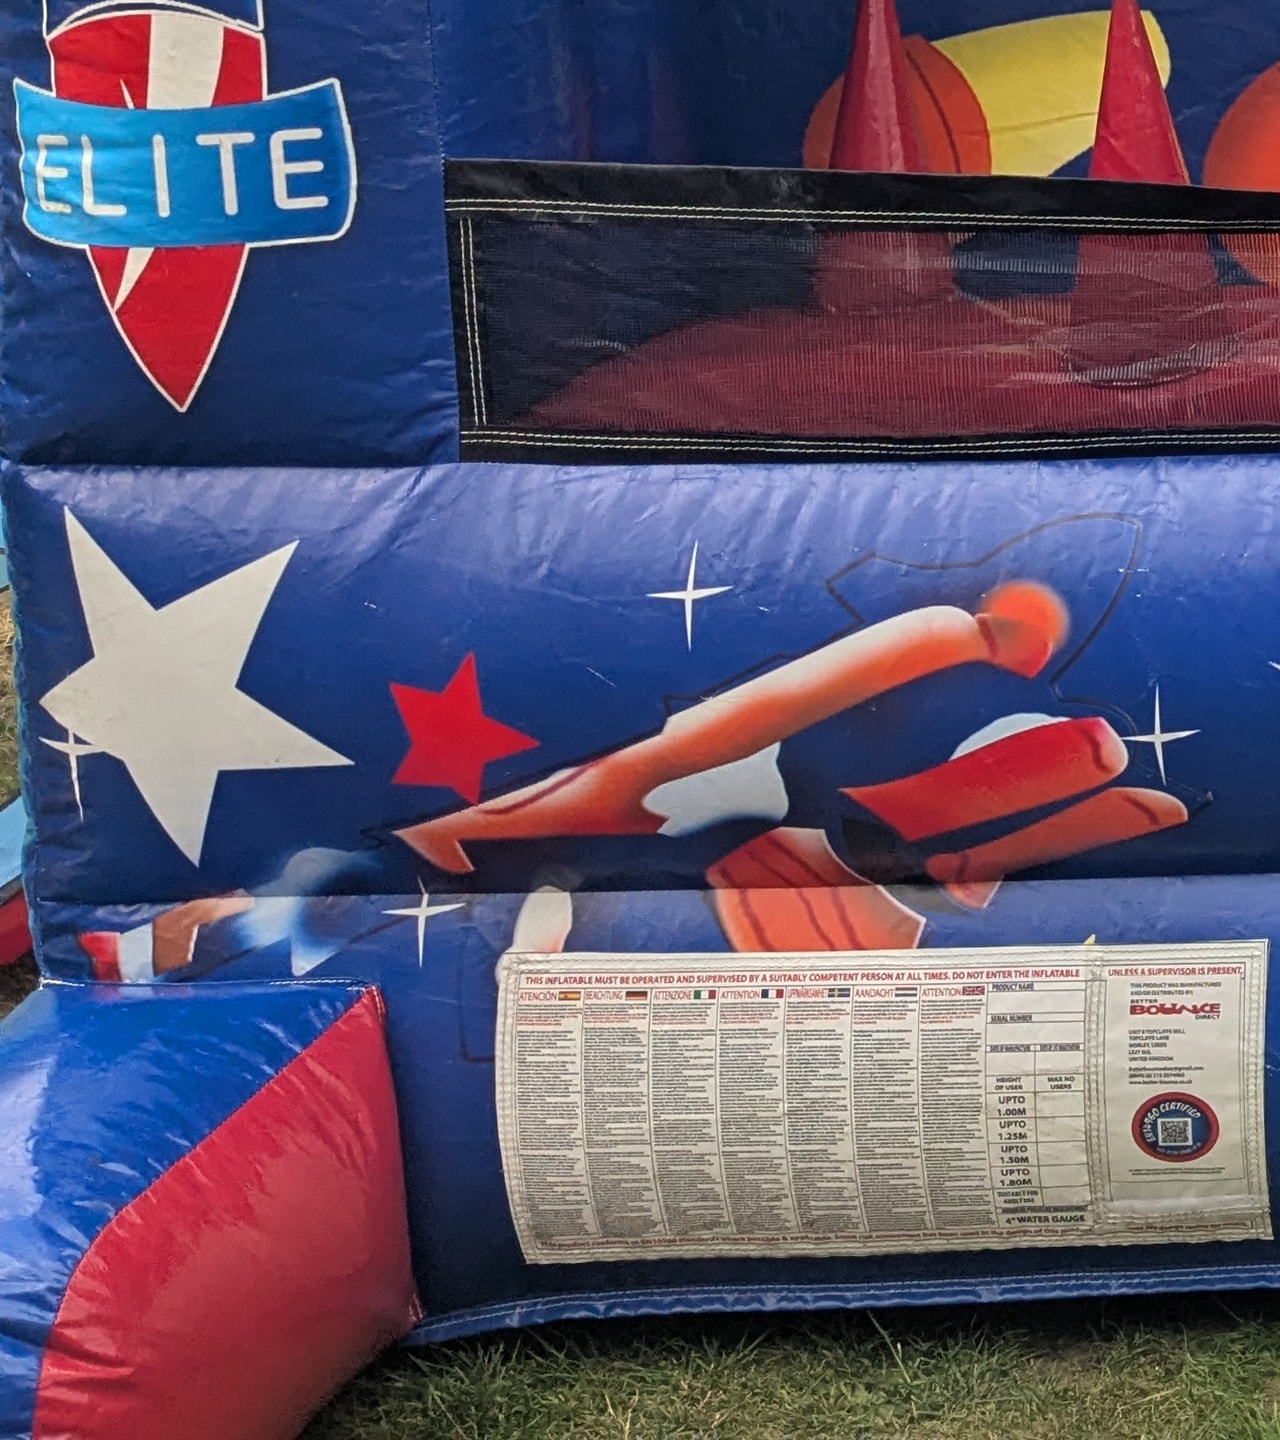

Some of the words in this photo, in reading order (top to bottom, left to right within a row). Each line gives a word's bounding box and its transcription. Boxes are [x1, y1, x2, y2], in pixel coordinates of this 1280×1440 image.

[36, 128, 329, 218] ELITE
[526, 976, 543, 985] THIS
[545, 976, 593, 985] INFLATABLE
[594, 976, 618, 985] MUST
[620, 976, 630, 984] BE
[632, 975, 674, 984] OPERATED
[676, 975, 696, 984] AND
[697, 974, 747, 983] SUPERVISED
[749, 974, 760, 983] BY
[761, 974, 767, 982] A
[769, 973, 808, 982] SUITABLY
[809, 973, 860, 982] COMPETENT
[861, 972, 893, 981] PERSON
[895, 972, 906, 980] AT
[907, 972, 922, 981] ALL
[952, 971, 965, 980] DO
[967, 971, 984, 979] NOT
[986, 970, 1012, 979] ENTER
[1012, 970, 1029, 978] THE
[1031, 969, 1080, 978] INFLATABLE
[1108, 968, 1140, 976] UNLESS
[1141, 968, 1146, 976] A
[1147, 967, 1196, 976] SUPERVISOR
[1198, 967, 1206, 975] IS
[922, 987, 961, 997] ATTENTION
[992, 983, 1017, 991] PRODUCT
[519, 990, 557, 1001] ATENCIÓN
[585, 990, 623, 1000] BEACHTUNG
[653, 990, 693, 1000] ATTENZIONE
[721, 989, 760, 1000] ATTENTION
[855, 988, 895, 998] AANDACHT
[1130, 1002, 1221, 1015] BOUNCE
[998, 1096, 1025, 1104] UPTO
[997, 1108, 1026, 1116] 1.00M
[1160, 1102, 1201, 1118] CERTIFIED
[999, 1120, 1026, 1128] UPTO
[998, 1132, 1027, 1140] 1.25M
[1001, 1145, 1028, 1153] UPTO
[1001, 1168, 1030, 1176] UPTO
[1017, 1215, 1049, 1223] WATER
[1052, 1215, 1085, 1223] GAUGE
